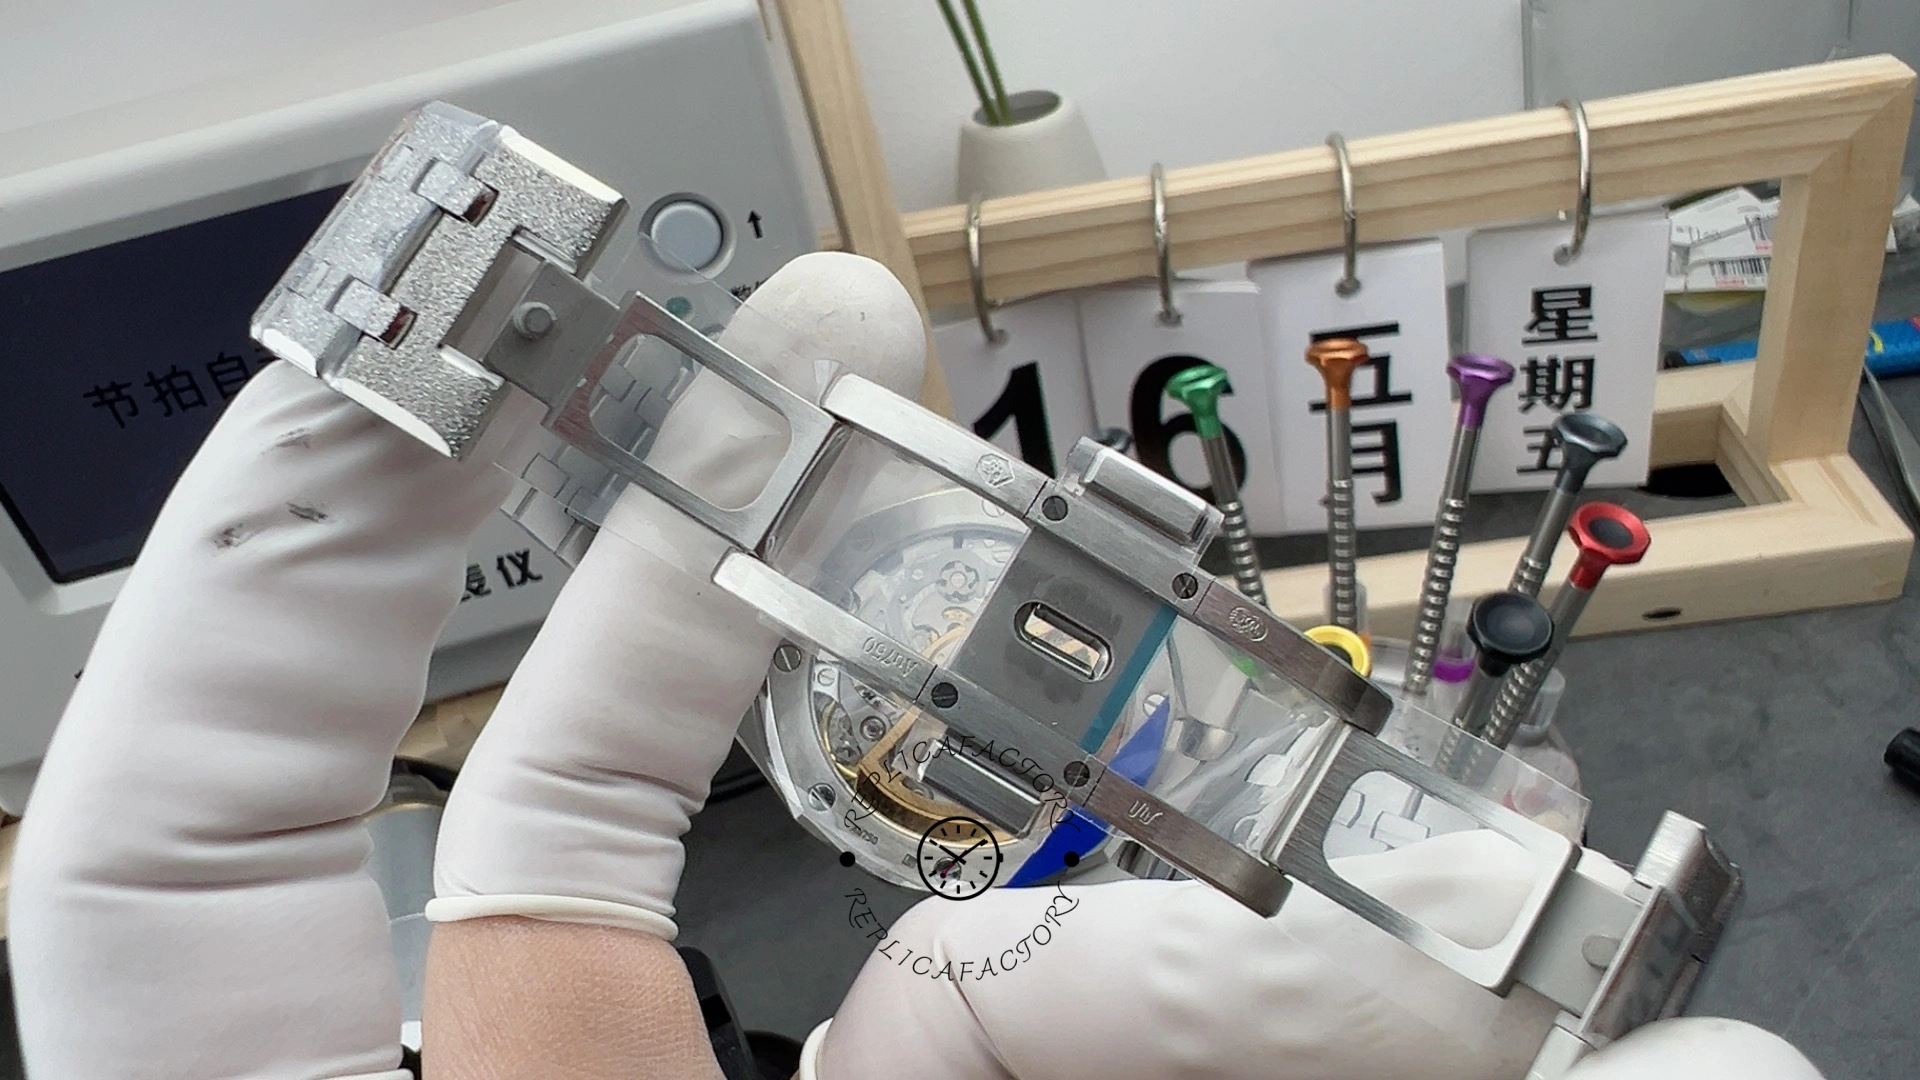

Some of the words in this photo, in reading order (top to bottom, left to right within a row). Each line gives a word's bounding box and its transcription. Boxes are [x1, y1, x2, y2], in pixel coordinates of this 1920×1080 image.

[82, 348, 281, 429] 节拍自
[1308, 320, 1413, 503] 五月
[861, 637, 919, 678] Au750
